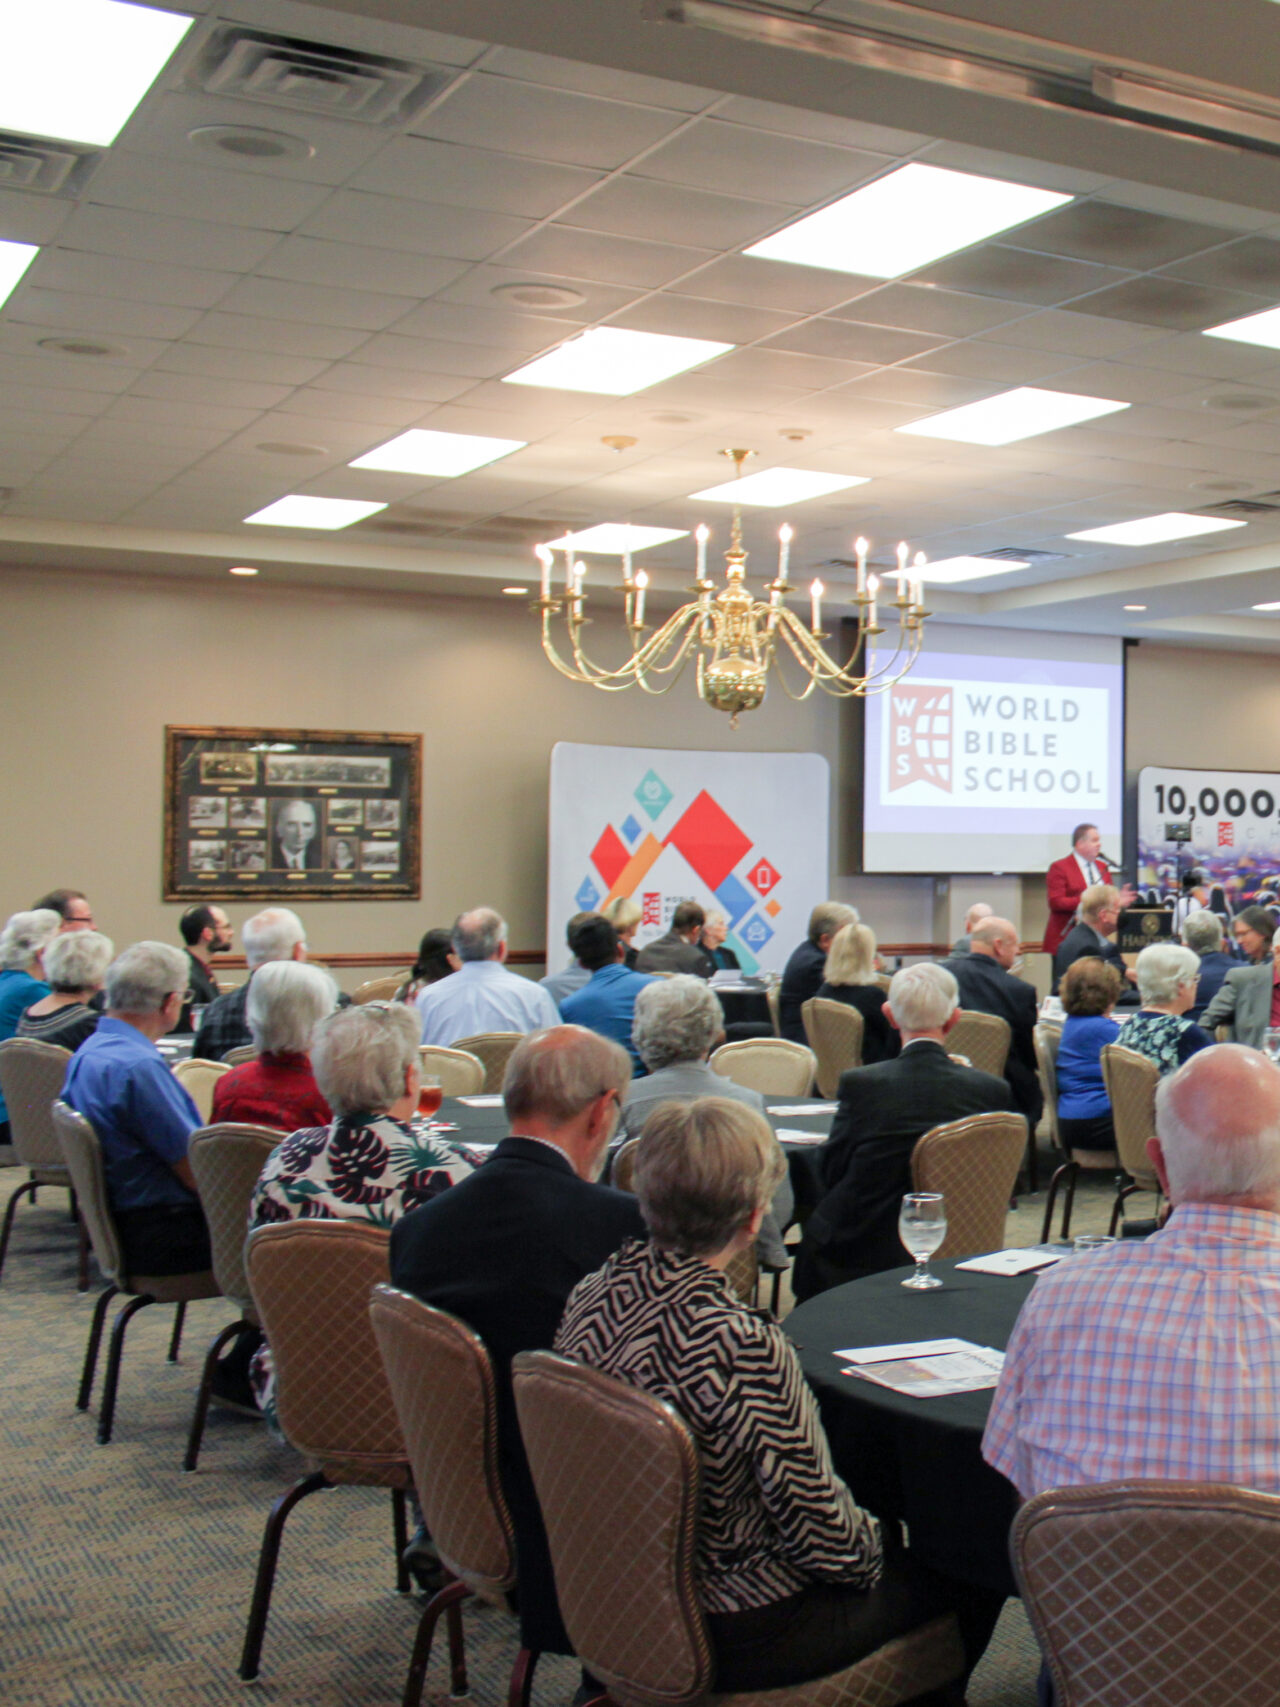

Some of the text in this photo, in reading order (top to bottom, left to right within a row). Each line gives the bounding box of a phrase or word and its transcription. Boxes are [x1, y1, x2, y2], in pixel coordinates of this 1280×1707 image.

[965, 694, 1080, 722] WORLD
[964, 731, 1058, 757] BIBLE
[964, 767, 1101, 794] SCHOOL
